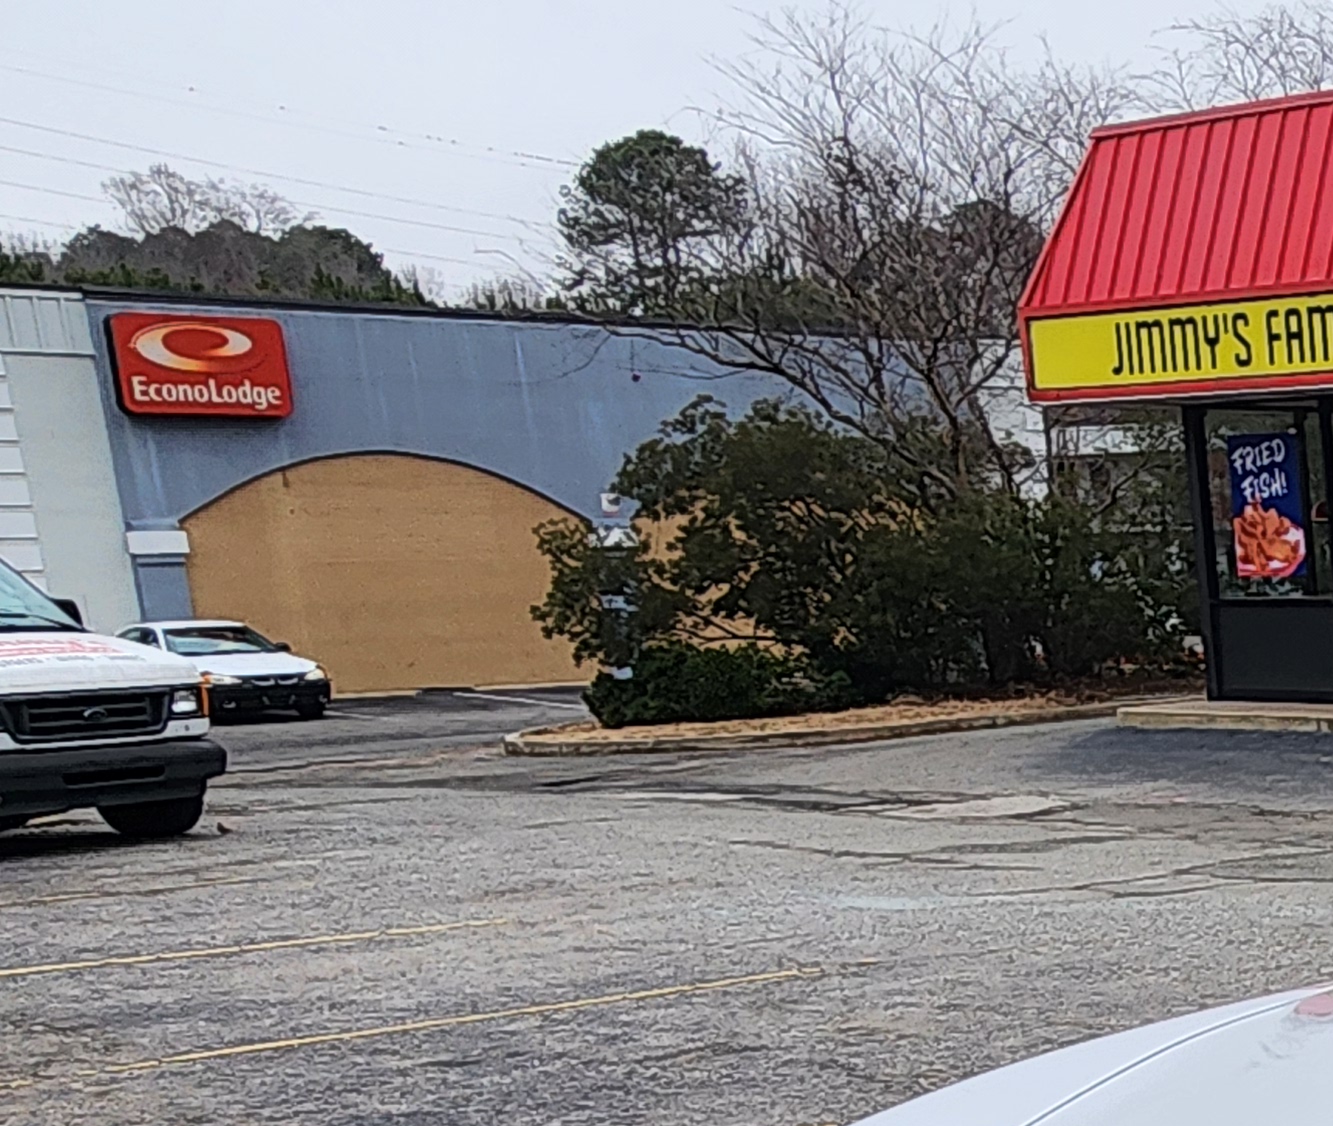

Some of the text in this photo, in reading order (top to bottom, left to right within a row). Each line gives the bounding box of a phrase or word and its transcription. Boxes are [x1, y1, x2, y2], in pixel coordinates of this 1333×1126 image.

[1111, 312, 1252, 376] JIMMY'S
[130, 375, 283, 410] EconoLodge
[1230, 438, 1285, 475] FRIED
[1240, 468, 1288, 503] FISH!
